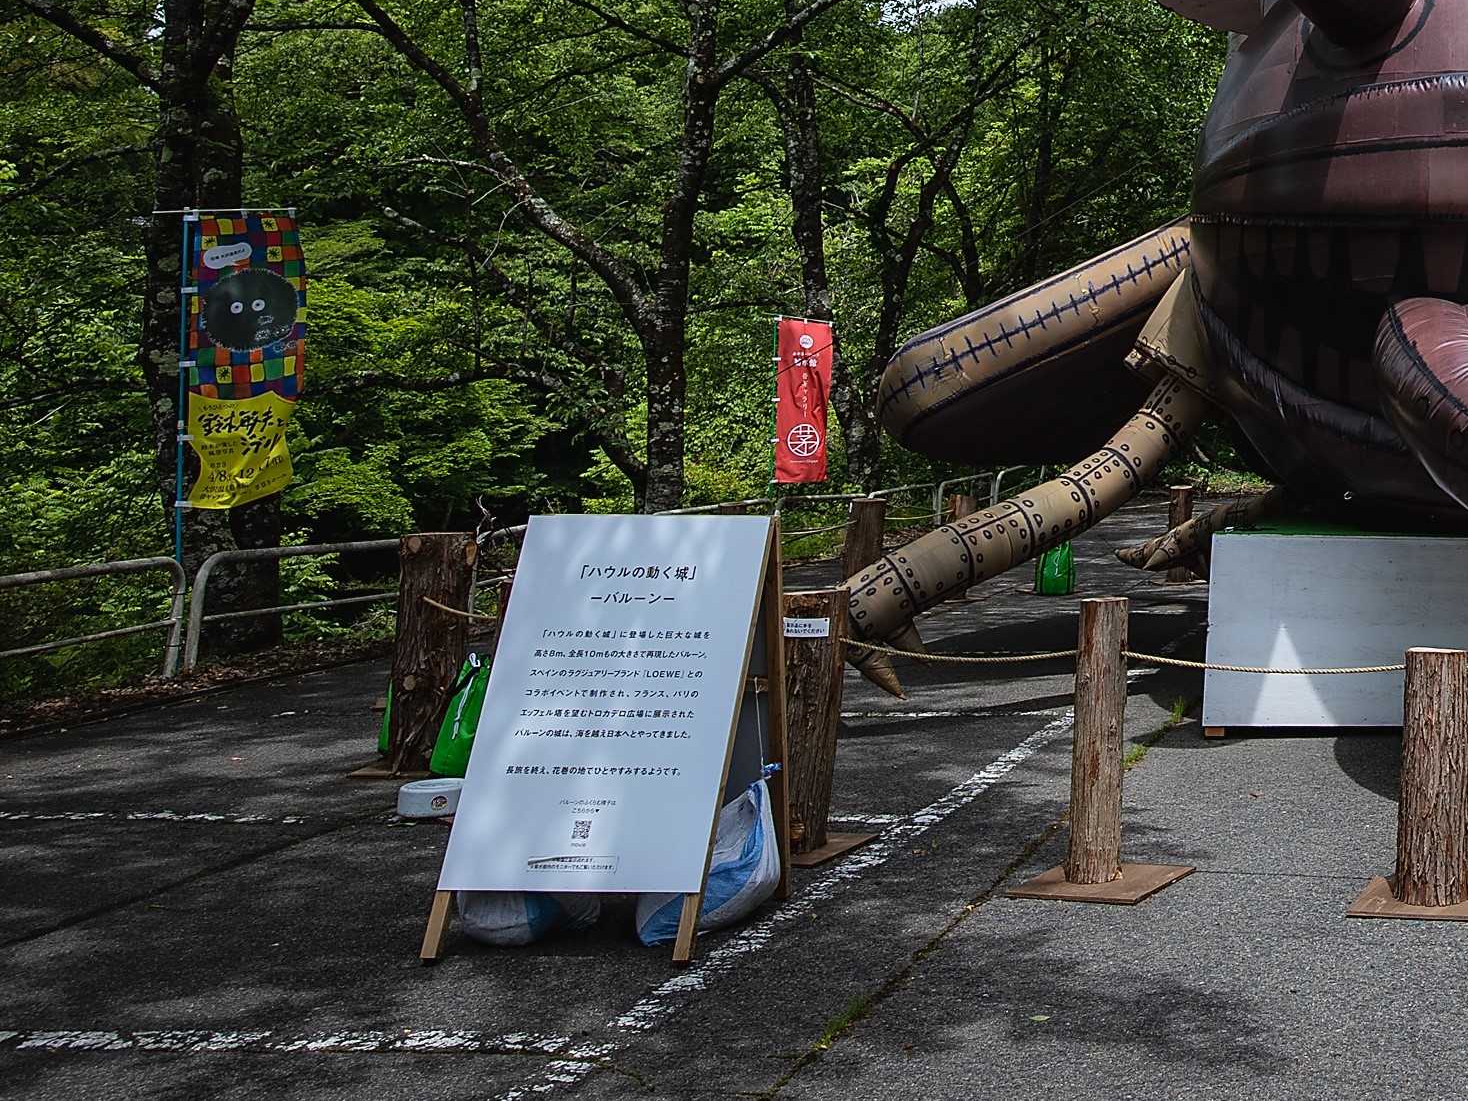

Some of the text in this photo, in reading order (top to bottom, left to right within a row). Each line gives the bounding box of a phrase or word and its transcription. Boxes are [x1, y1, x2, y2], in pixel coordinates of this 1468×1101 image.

[580, 565, 697, 582] 「ハウルの動く城」
[520, 709, 695, 719] エッフェル塔を望むトロカデロ広場に展示された
[514, 729, 691, 739] バルーンの城は、海を越え日本へとやってきました。
[505, 765, 681, 776] 長旅を終え、花巻の地でひとやすみするようです。
